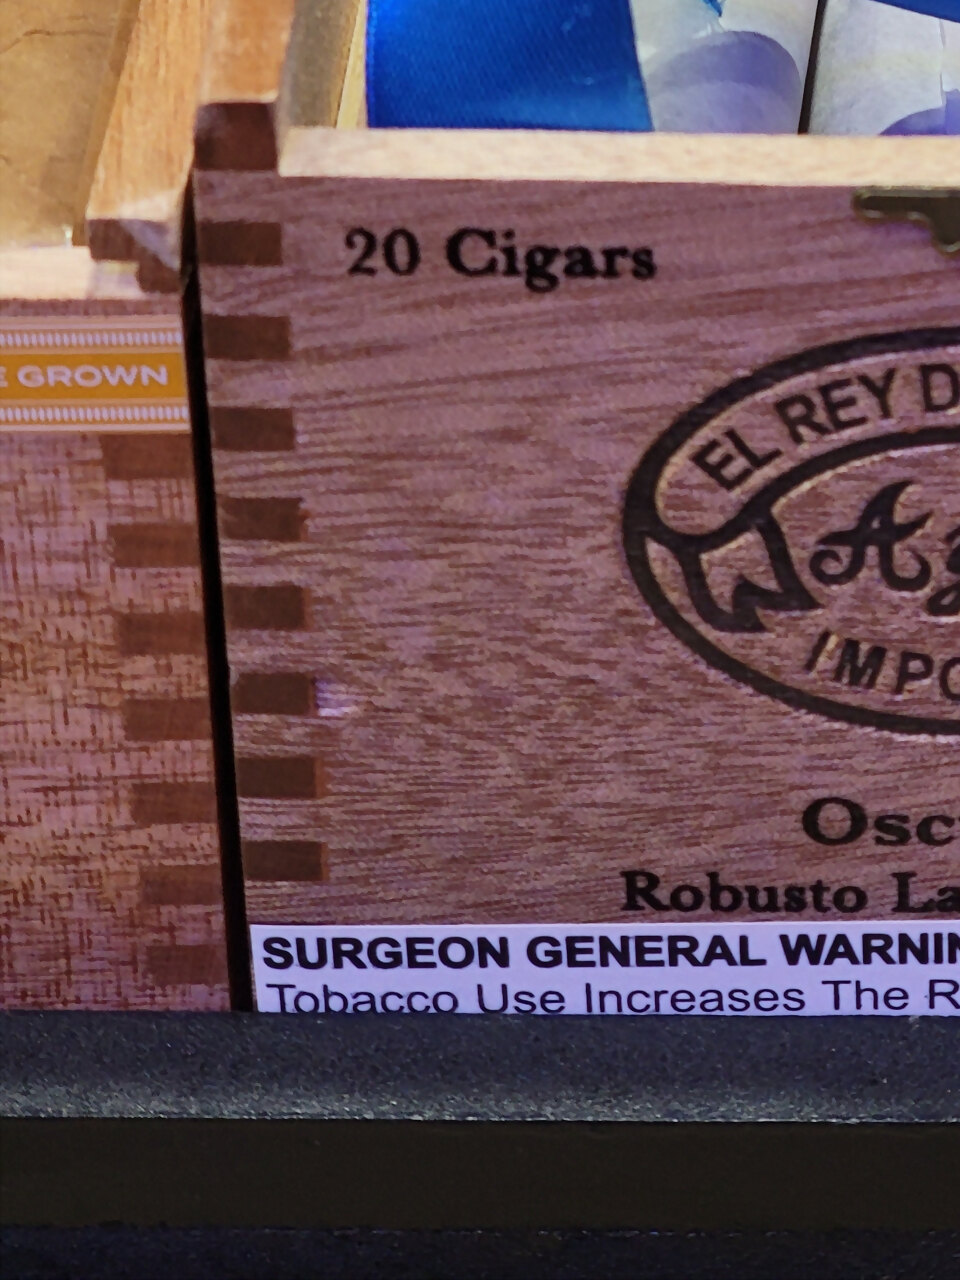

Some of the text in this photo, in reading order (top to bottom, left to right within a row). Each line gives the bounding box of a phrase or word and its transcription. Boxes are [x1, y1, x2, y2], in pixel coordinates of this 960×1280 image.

[345, 226, 658, 294] 20 Cigars
[17, 364, 168, 388] GROWN
[690, 429, 784, 492] EL
[774, 368, 897, 445] REY
[809, 479, 936, 593] A
[620, 870, 869, 916] Robusto
[262, 936, 511, 970] SURGEON
[525, 933, 768, 969] GENERAL
[265, 983, 459, 1015] Tobacco
[476, 983, 566, 1015] Use
[585, 981, 806, 1014] Increases
[821, 979, 910, 1012] The
